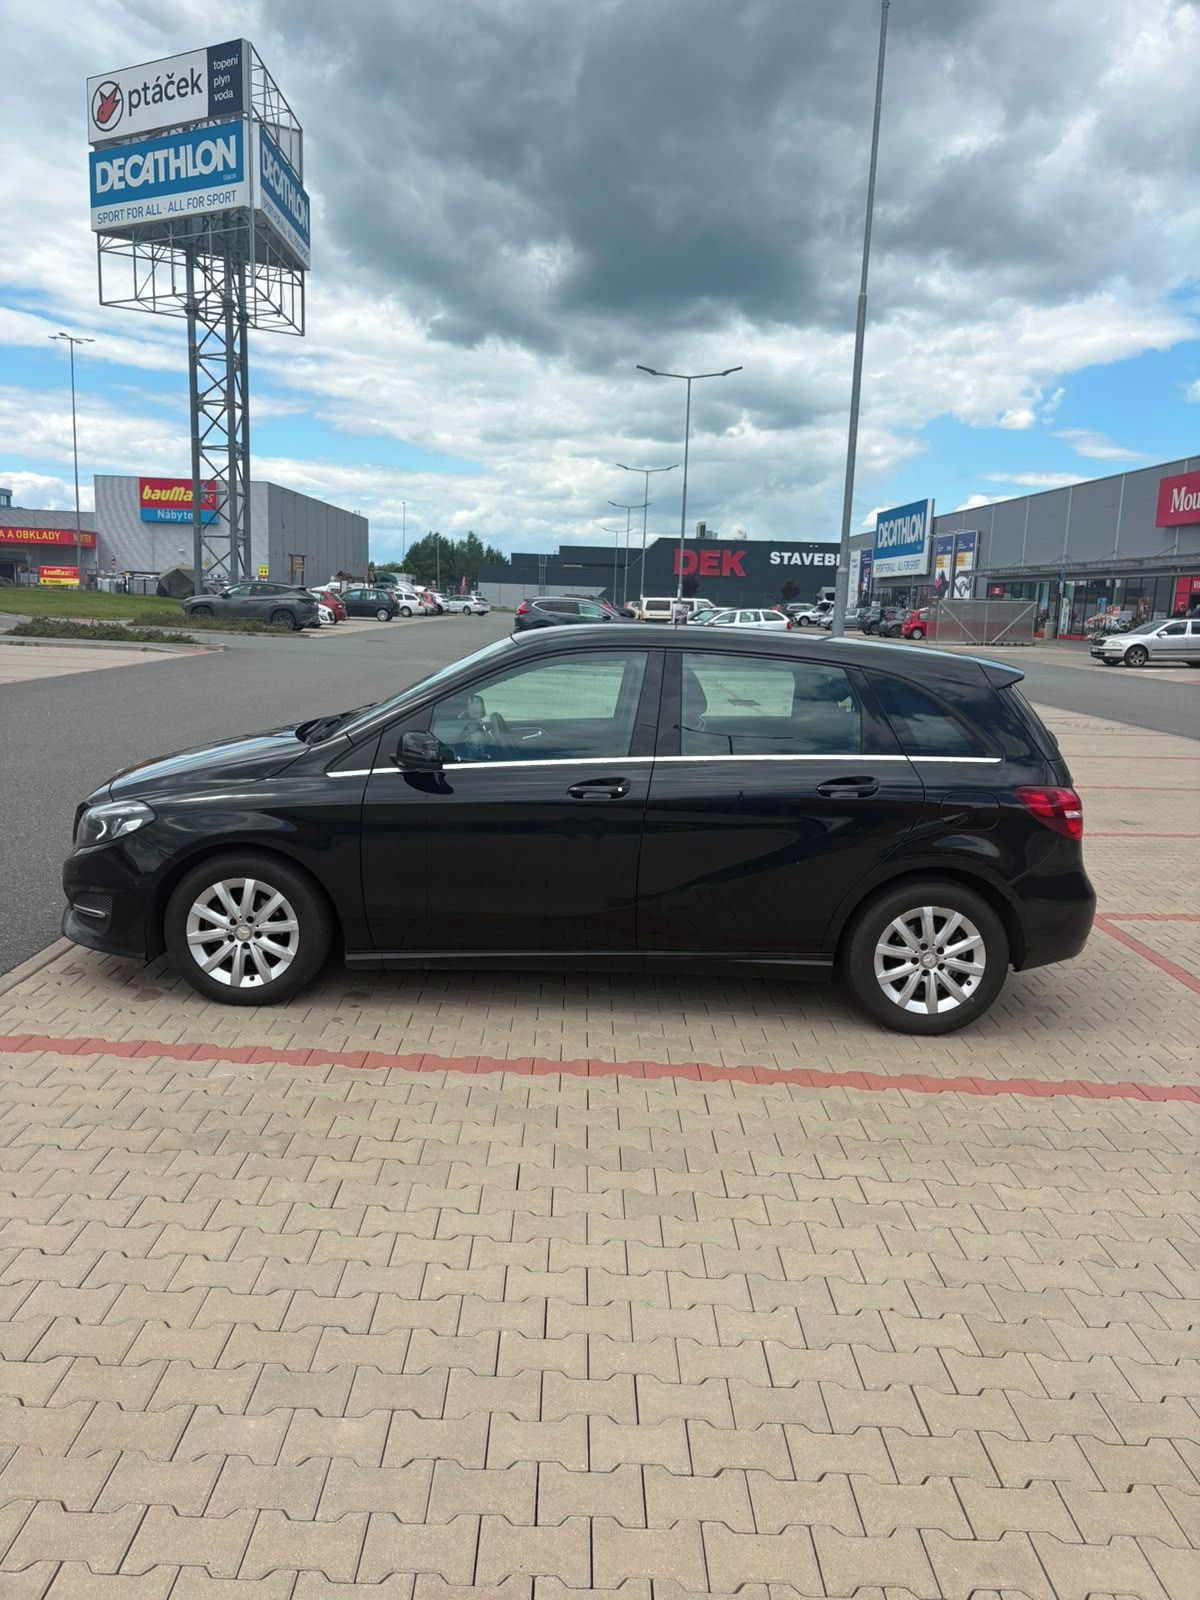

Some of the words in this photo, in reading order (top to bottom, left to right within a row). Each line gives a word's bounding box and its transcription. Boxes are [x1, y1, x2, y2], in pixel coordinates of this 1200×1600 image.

[213, 54, 239, 70] topení
[128, 67, 203, 117] ptáček
[213, 74, 230, 88] plyn
[213, 89, 233, 101] voda
[95, 134, 237, 194] DECATHLON
[97, 208, 125, 224] SPORT
[126, 205, 145, 219] FOR
[145, 202, 162, 216] ALL
[168, 199, 185, 213] ALL
[186, 194, 207, 210] FOR
[206, 189, 237, 206] SPORT
[157, 508, 194, 521] Nábyte
[7, 529, 14, 538] A
[15, 529, 61, 541] OBKLADY
[877, 511, 925, 549] DECATHLON
[673, 548, 747, 577] DEK
